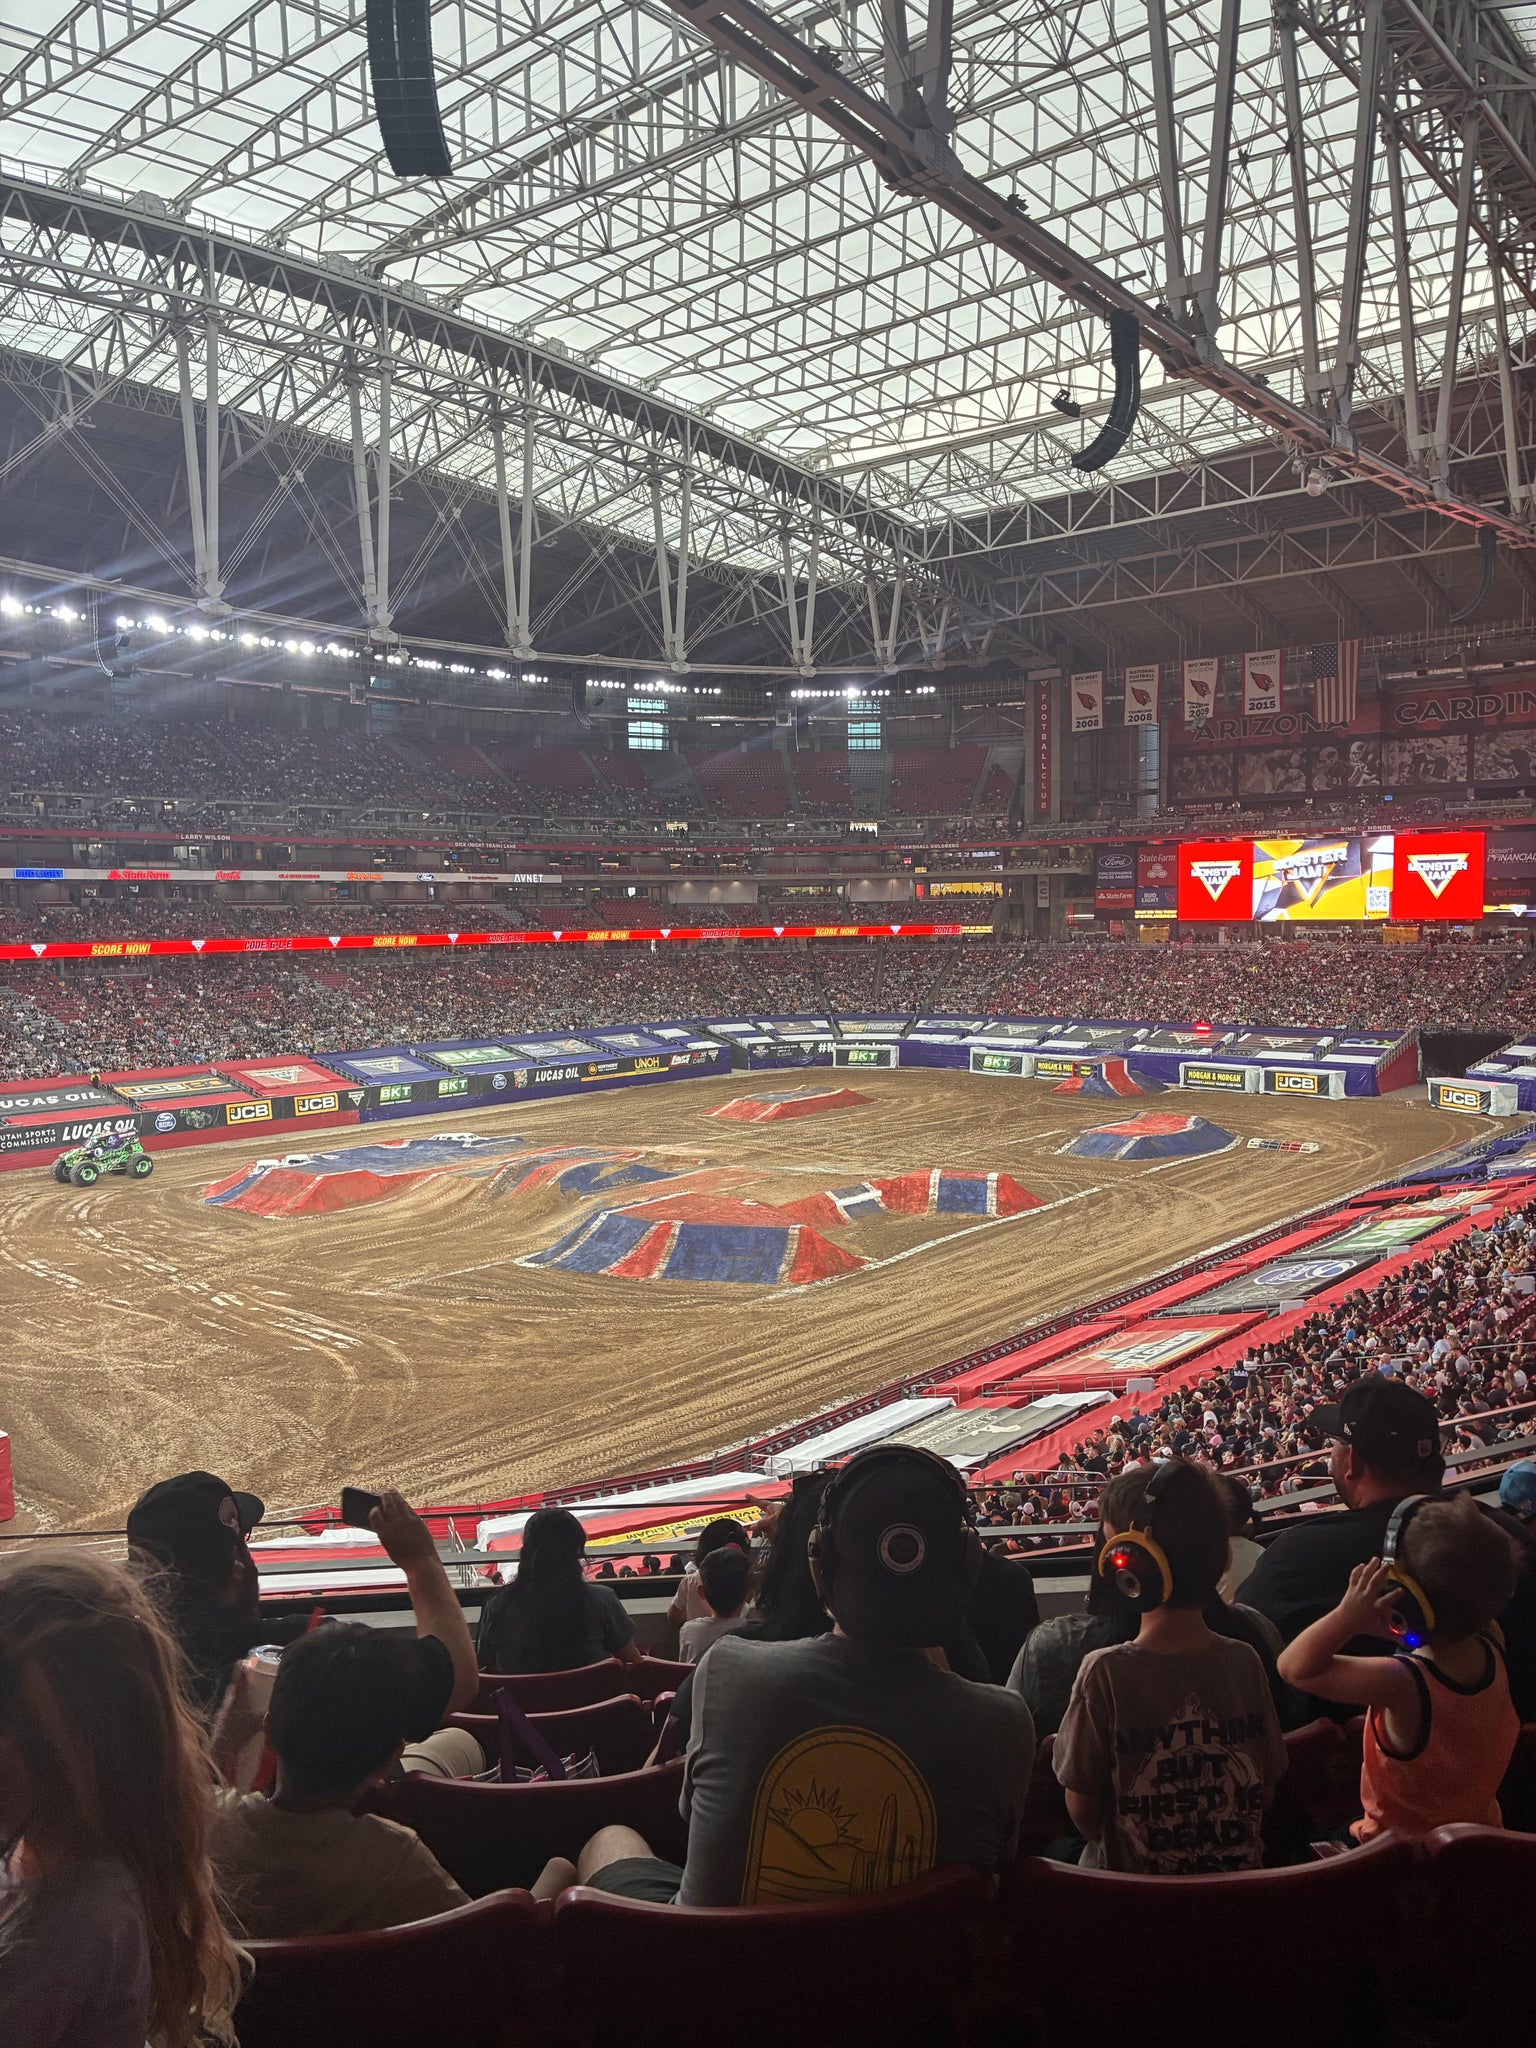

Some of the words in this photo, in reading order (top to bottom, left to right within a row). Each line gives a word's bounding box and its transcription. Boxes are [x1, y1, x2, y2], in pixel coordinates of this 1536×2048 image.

[1249, 700, 1275, 711] 2015
[1128, 713, 1152, 723] 2008
[1189, 707, 1210, 718] 2009
[1075, 719, 1099, 729] 2008
[1104, 857, 1126, 866] Ford
[1272, 848, 1348, 870] MONSTER
[1191, 867, 1241, 877] MONSTER
[1283, 863, 1325, 880] JAM
[1408, 861, 1468, 872] MONSTER
[514, 874, 543, 883] AVNET
[1203, 876, 1227, 884] JAM
[1424, 870, 1449, 880] JAM
[587, 932, 609, 940] SCORE
[611, 932, 631, 940] NOW!
[701, 930, 720, 938] CODE:
[815, 928, 840, 936] SCORE
[841, 928, 859, 936] NOW!
[244, 940, 268, 950] CODE:
[270, 939, 292, 949] G-L-E
[373, 936, 397, 946] SCORE
[399, 935, 418, 945] NOW!
[488, 935, 507, 943] CODE:
[509, 934, 526, 942] G-L-E
[91, 945, 123, 955] SCORE
[125, 944, 151, 954] NOW!
[849, 1050, 879, 1062] BKT
[983, 1055, 1011, 1069] BKT
[635, 1056, 660, 1070] UNOH
[1038, 1061, 1057, 1071] MORGAN
[535, 1068, 564, 1082] LUCAS
[1188, 1070, 1211, 1080] MORGAN
[1212, 1072, 1216, 1080] &
[1217, 1072, 1241, 1082] MORGAN
[440, 1079, 468, 1091] BKT
[1279, 1077, 1315, 1089] JCB
[382, 1086, 411, 1098] BKT
[299, 1096, 335, 1112] JCB
[1443, 1090, 1478, 1107] JCB
[231, 1104, 269, 1120] JCB
[0, 1134, 23, 1142] UTAH
[25, 1129, 56, 1138] SPORTS
[62, 1121, 112, 1141] LUCAS
[1, 1136, 57, 1149] COMMISSION
[1157, 1753, 1229, 1784] BUT
[1118, 1786, 1224, 1822] FIRST
[1147, 1818, 1247, 1853] DEAD
